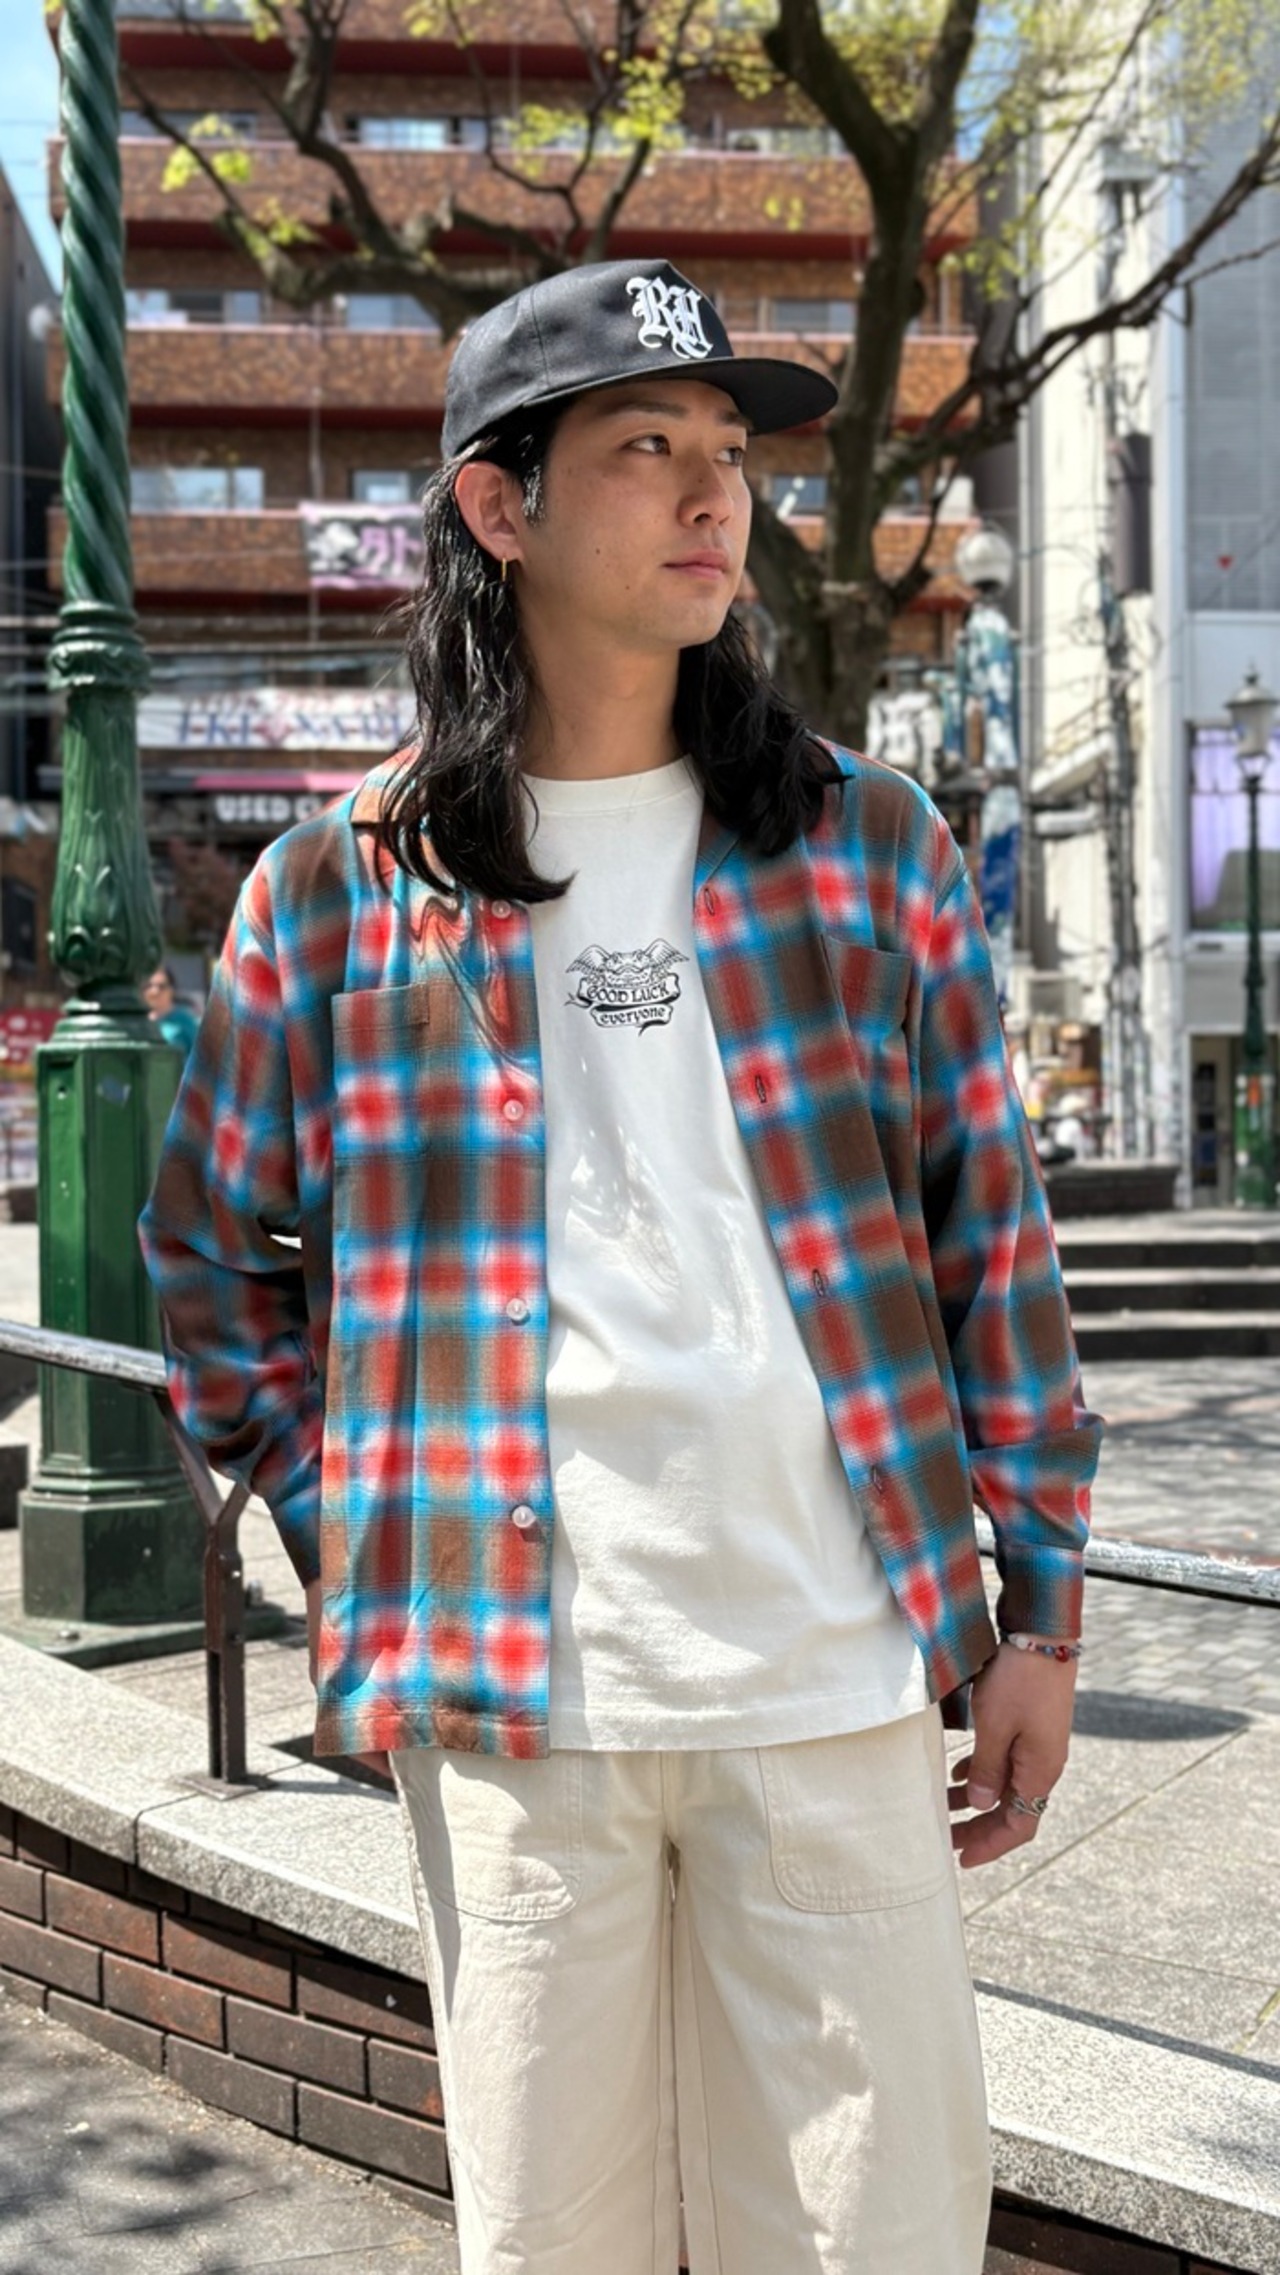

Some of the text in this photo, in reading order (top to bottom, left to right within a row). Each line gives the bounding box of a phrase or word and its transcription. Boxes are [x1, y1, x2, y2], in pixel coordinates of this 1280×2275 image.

[216, 794, 290, 822] USED
[587, 983, 670, 1003] GOOD LUCK
[600, 1006, 666, 1025] everyone
